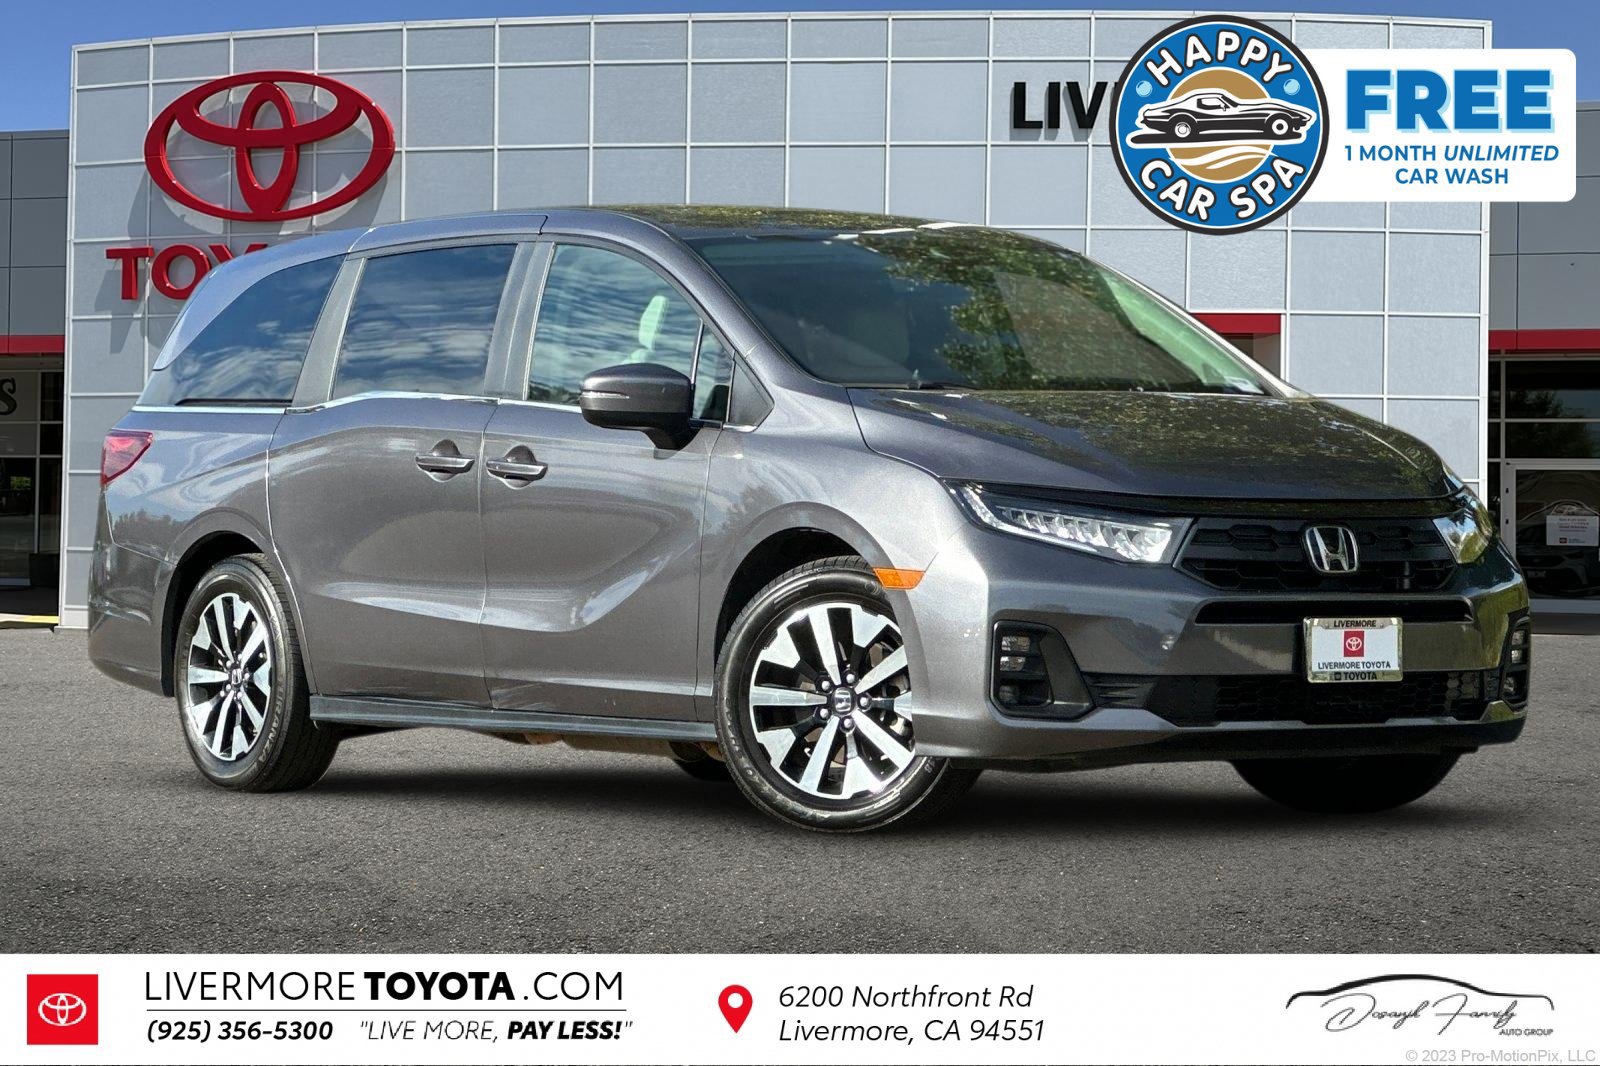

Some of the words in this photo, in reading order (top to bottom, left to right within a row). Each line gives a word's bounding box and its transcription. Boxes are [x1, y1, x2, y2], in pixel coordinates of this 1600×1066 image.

[1013, 82, 1119, 128] LIV
[1333, 619, 1377, 628] LIVERMORE
[1317, 660, 1360, 670] LIVERMORE
[1361, 660, 1391, 669] TOYOTA
[1344, 671, 1378, 681] TOYOTA
